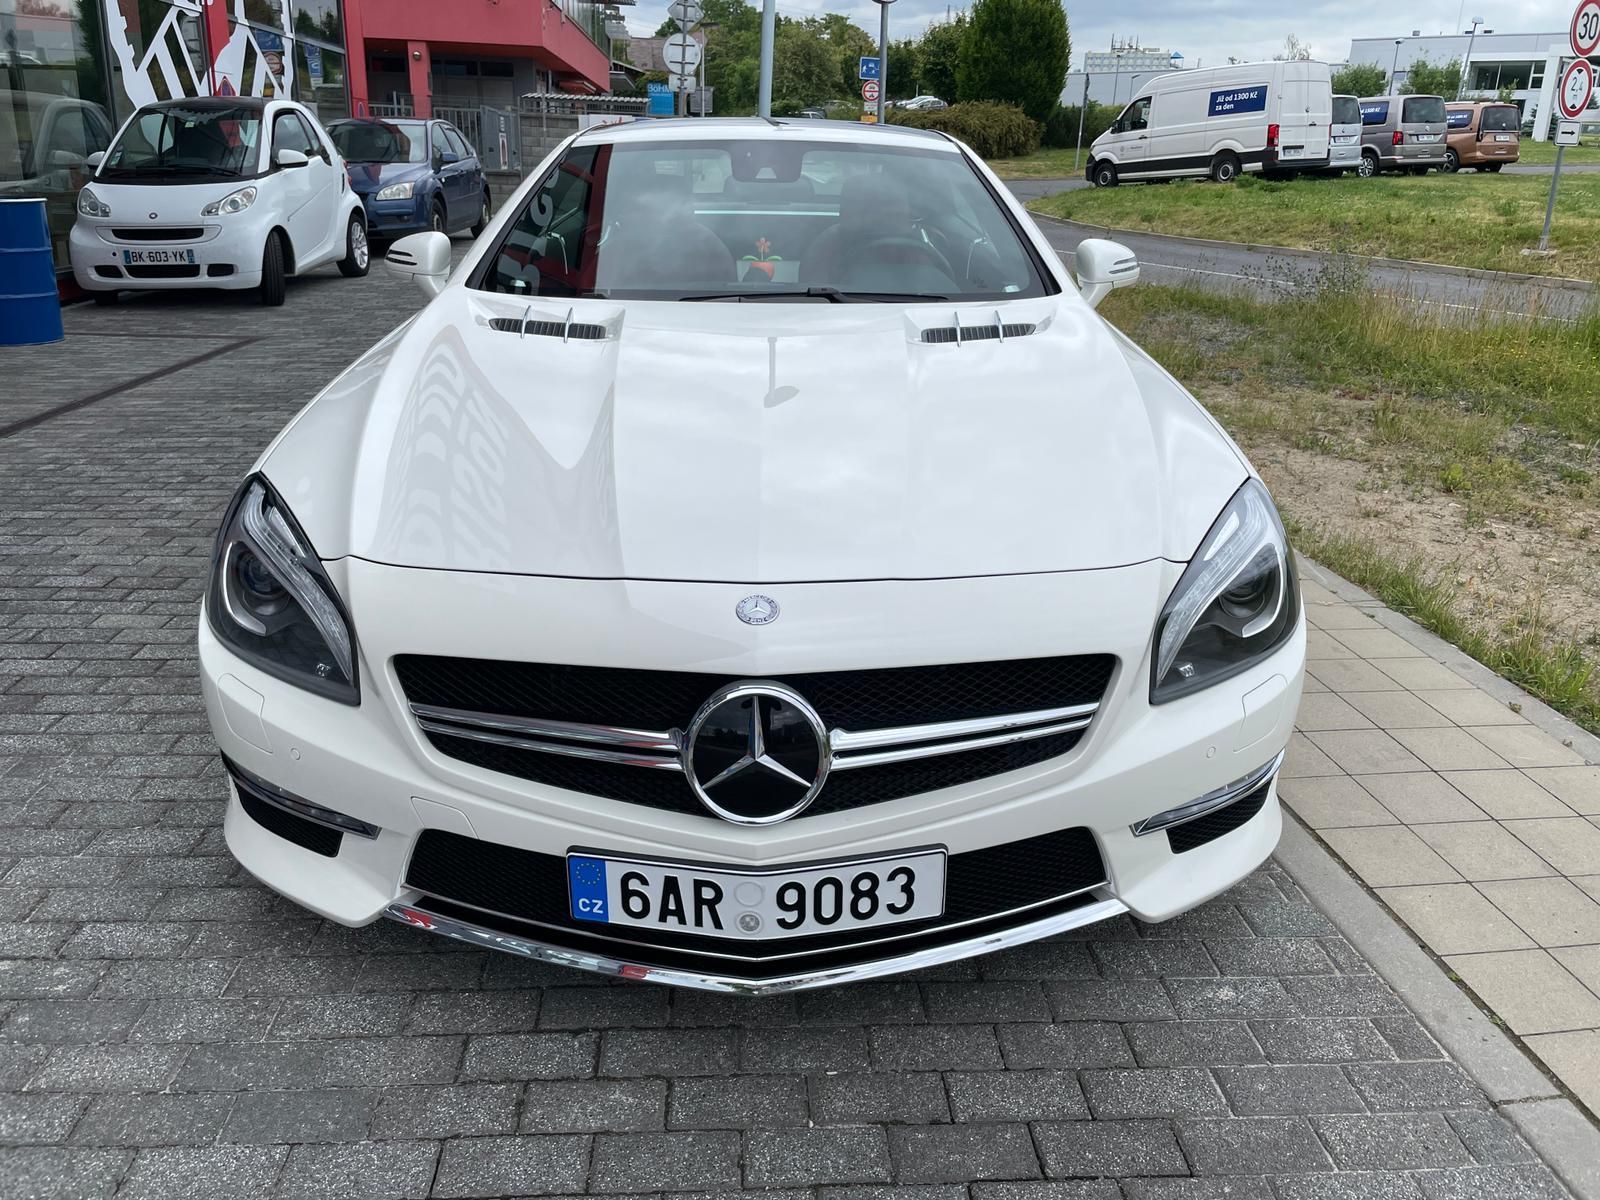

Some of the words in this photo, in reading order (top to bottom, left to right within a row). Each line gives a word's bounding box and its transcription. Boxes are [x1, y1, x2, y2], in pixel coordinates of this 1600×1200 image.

[1579, 12, 1599, 40] 30
[1225, 94, 1233, 102] od
[1234, 93, 1249, 101] 1300
[1250, 91, 1258, 99] Kč
[578, 898, 604, 914] CZ
[620, 871, 724, 930] 6AR
[776, 866, 916, 930] 9083
